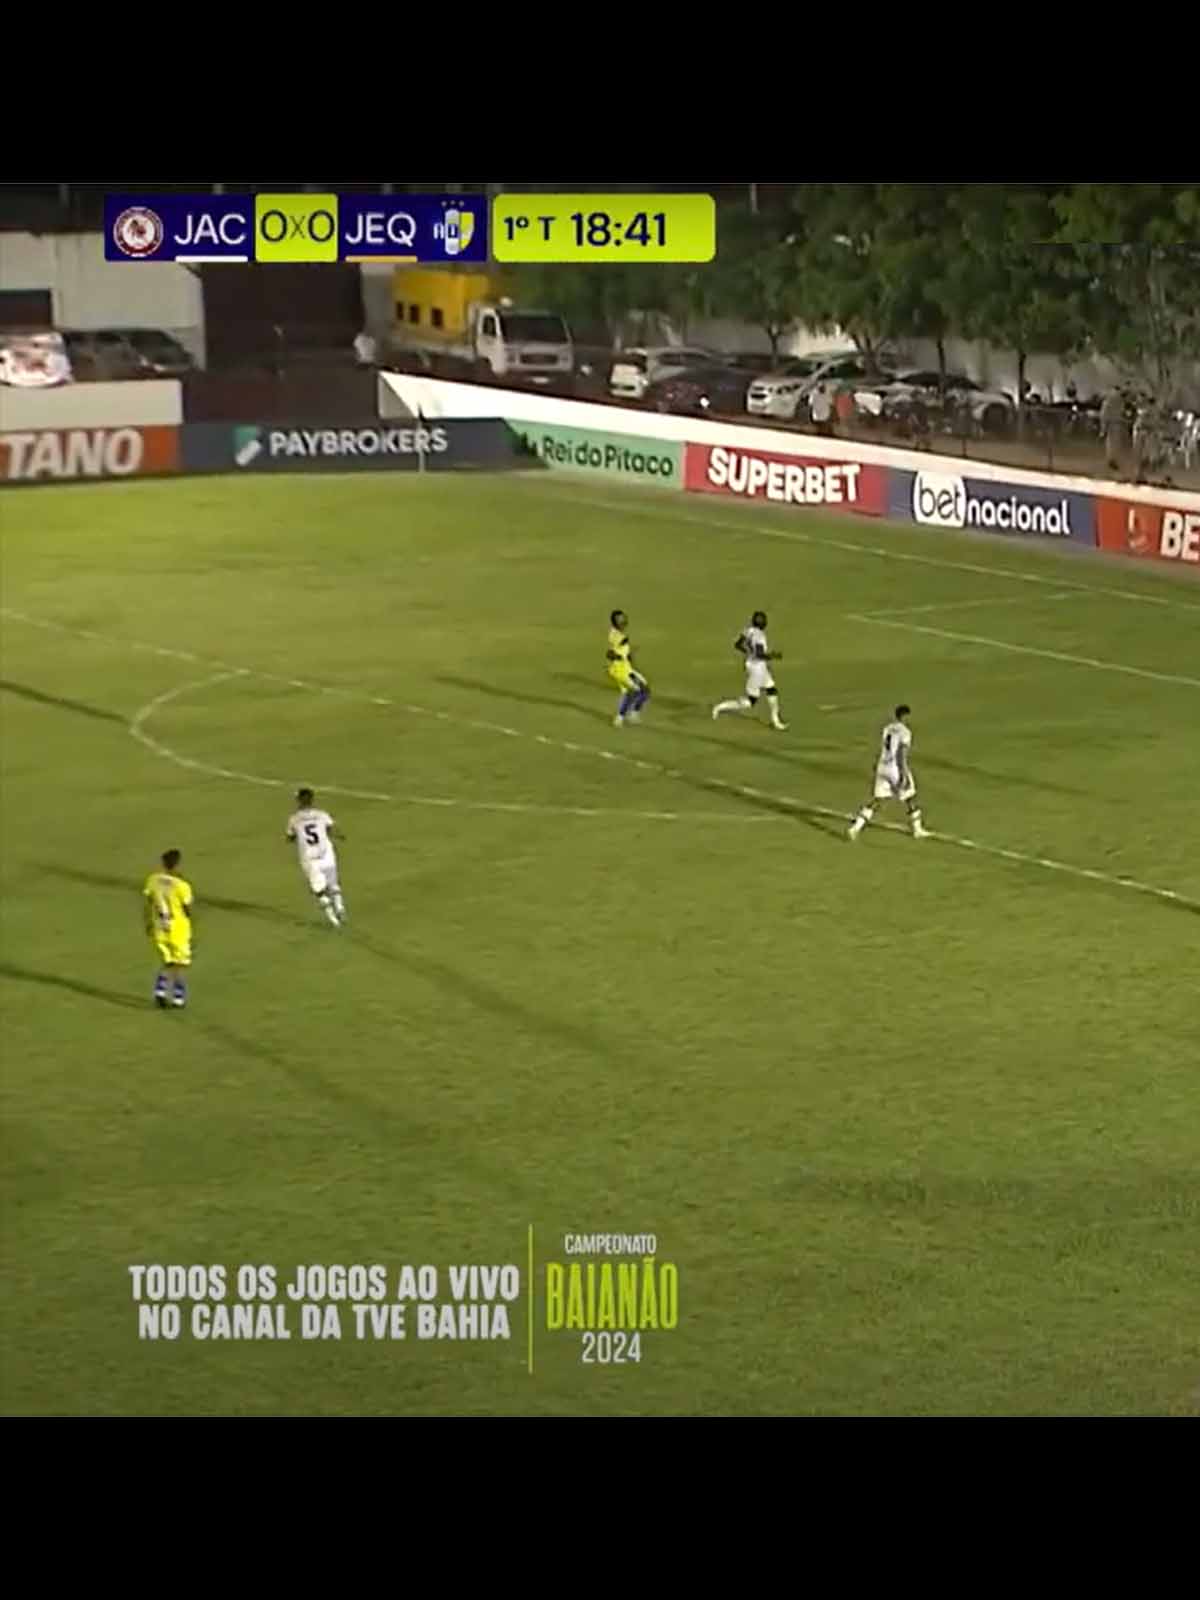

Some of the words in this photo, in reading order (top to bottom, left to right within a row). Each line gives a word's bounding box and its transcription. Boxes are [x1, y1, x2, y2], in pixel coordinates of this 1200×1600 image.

[269, 427, 449, 457] PAYBROKERS
[708, 448, 861, 503] SUPERBET
[304, 823, 319, 845] 5
